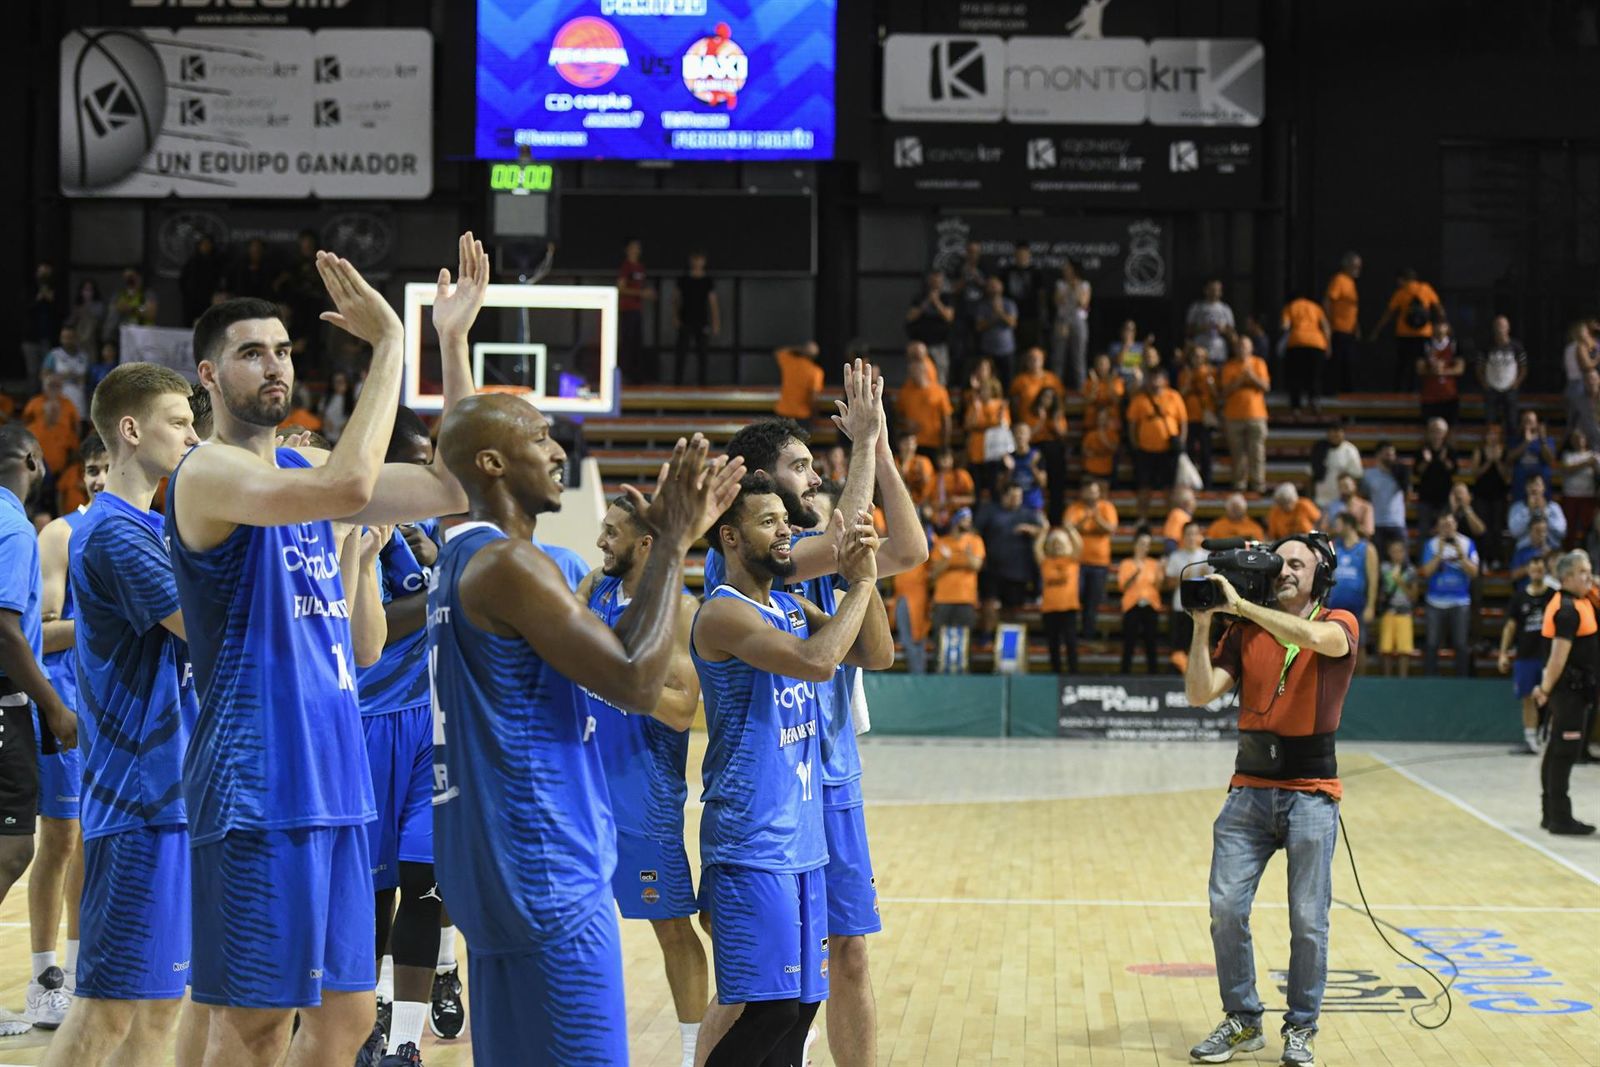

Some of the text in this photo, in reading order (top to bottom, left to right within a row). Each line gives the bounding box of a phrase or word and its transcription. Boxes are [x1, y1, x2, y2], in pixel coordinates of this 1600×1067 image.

[640, 56, 673, 76] VS
[156, 152, 418, 176] UN EQUIPO GANADOR
